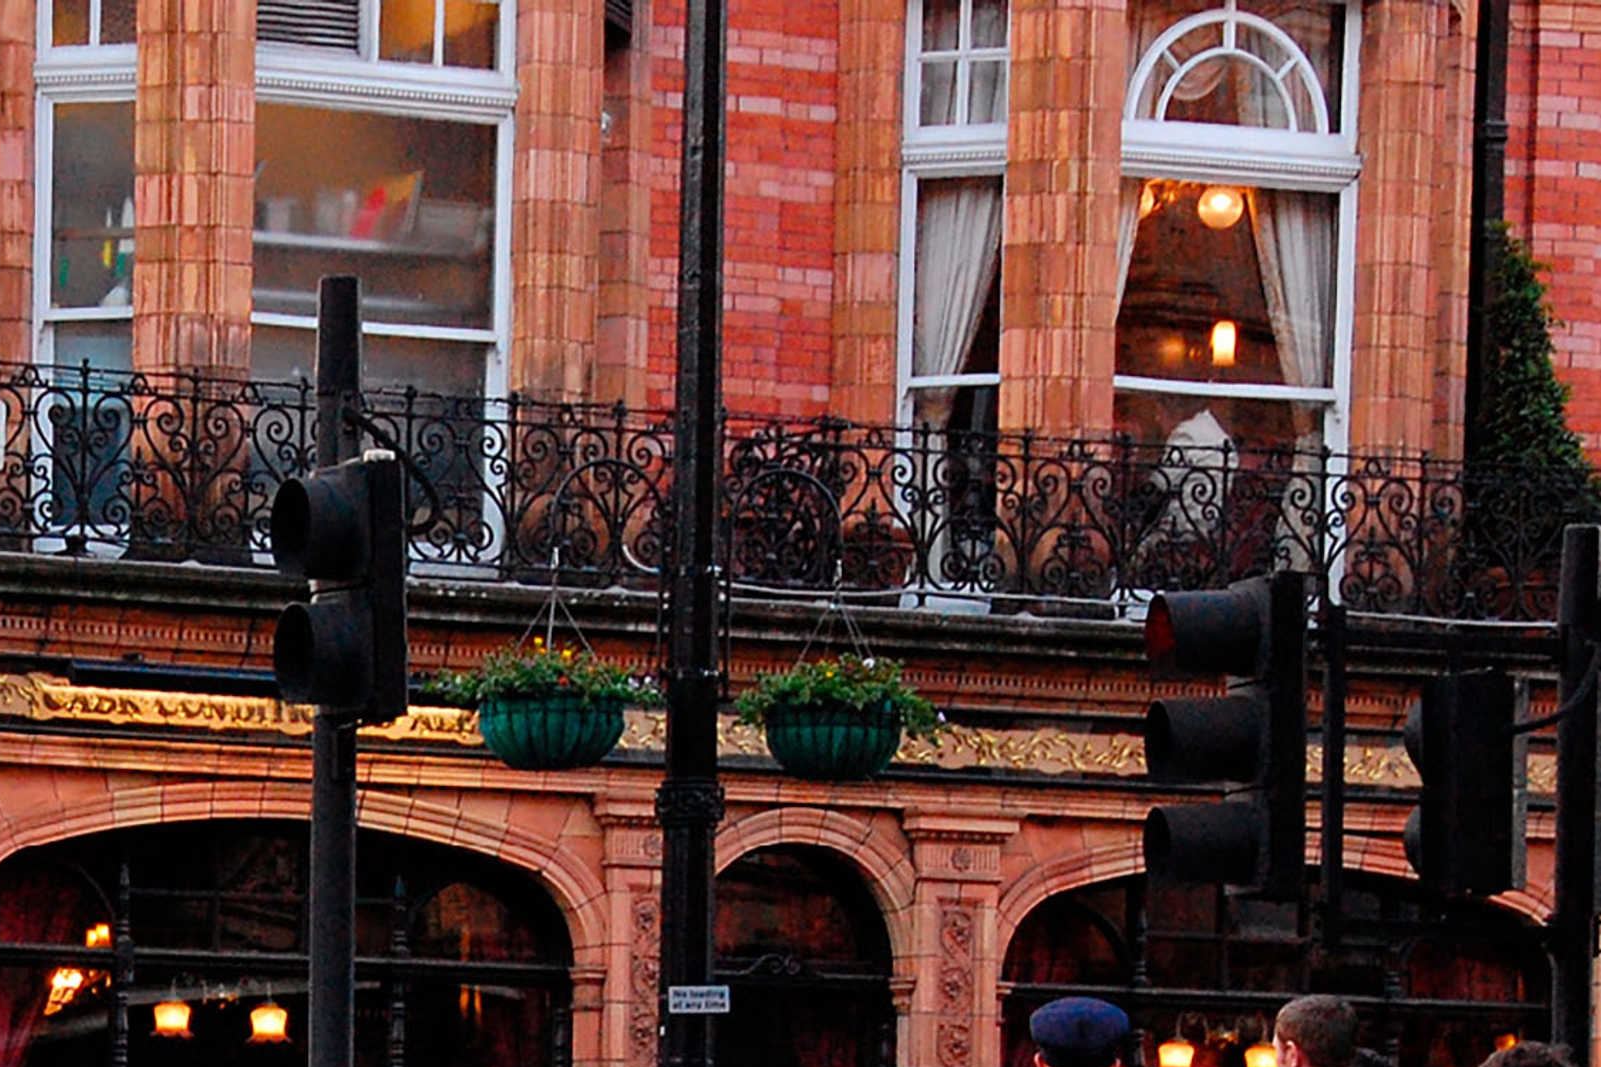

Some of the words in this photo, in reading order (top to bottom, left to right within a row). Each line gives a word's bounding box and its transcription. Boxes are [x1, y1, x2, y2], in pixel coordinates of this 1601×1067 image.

[672, 989, 687, 999] No
[690, 989, 726, 1000] loading
[672, 1001, 683, 1010] at
[685, 1002, 702, 1011] any
[704, 1001, 726, 1010] time
